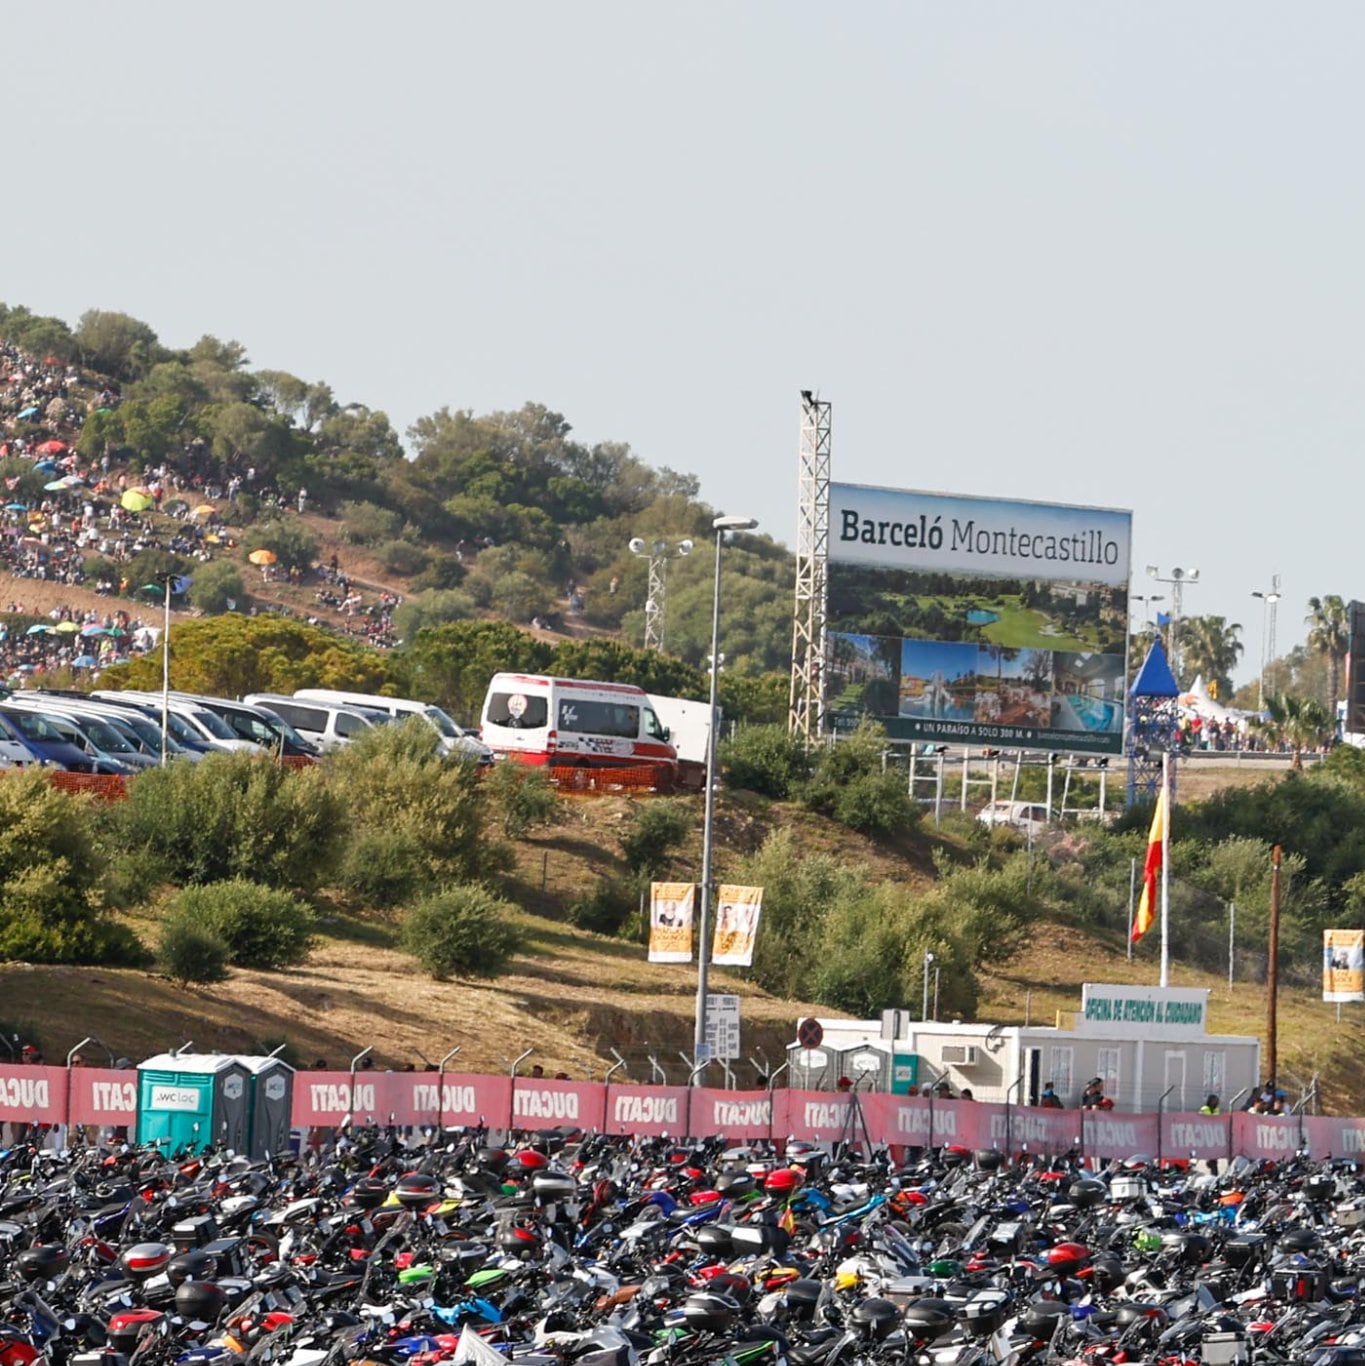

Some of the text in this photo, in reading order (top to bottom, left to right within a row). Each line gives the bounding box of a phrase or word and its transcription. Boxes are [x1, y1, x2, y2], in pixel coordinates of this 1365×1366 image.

[840, 509, 1119, 565] Barceló Montecastillo
[923, 723, 935, 733] UN
[937, 724, 968, 736] PARAÍSO
[978, 728, 998, 738] SOLO
[1086, 998, 1111, 1020] OFICINA
[1114, 999, 1122, 1021] DE
[1123, 994, 1155, 1022] ATENCIÓN
[1165, 1001, 1202, 1024] CIUDADANO
